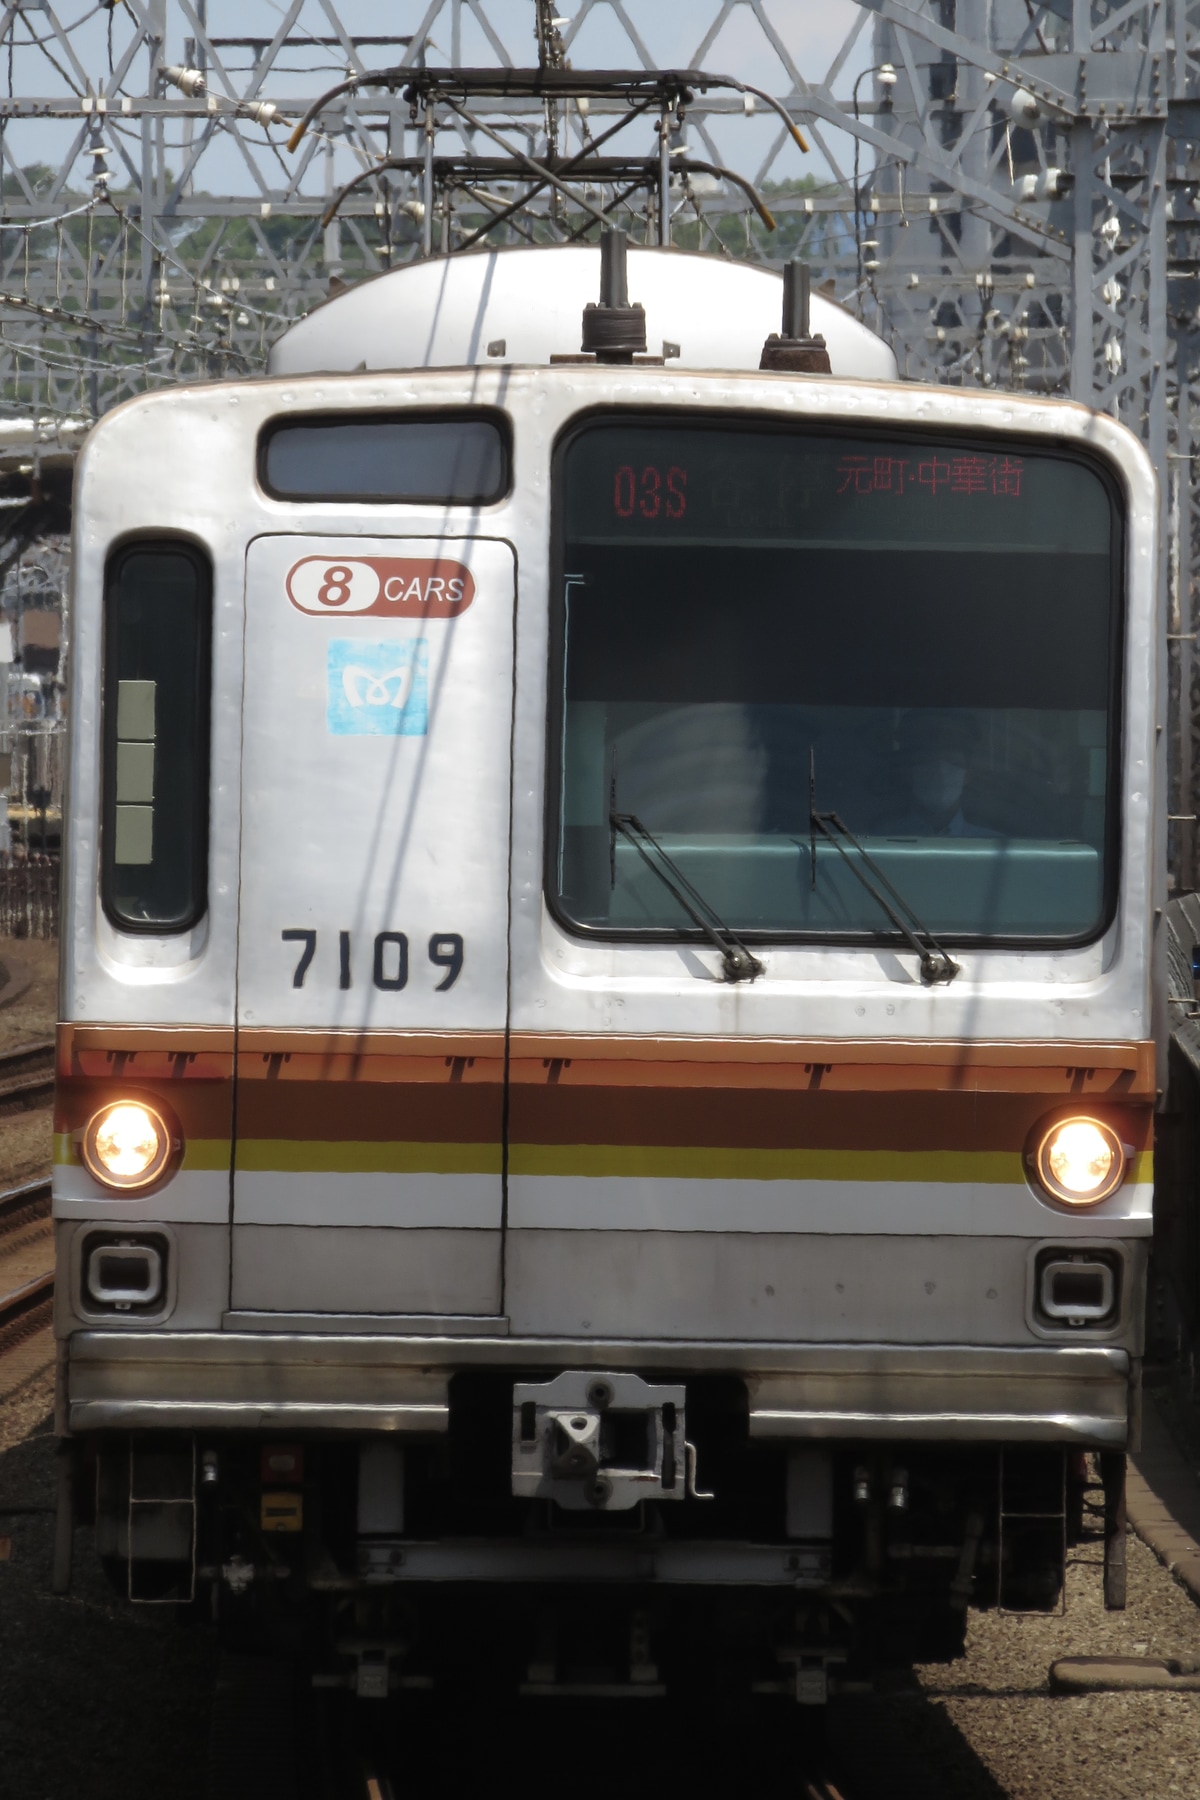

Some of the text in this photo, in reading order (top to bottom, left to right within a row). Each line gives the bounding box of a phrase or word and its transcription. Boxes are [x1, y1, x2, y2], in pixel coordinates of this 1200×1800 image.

[614, 465, 687, 518] 03S
[317, 565, 465, 607] 8 CARS
[281, 929, 464, 992] 7109
